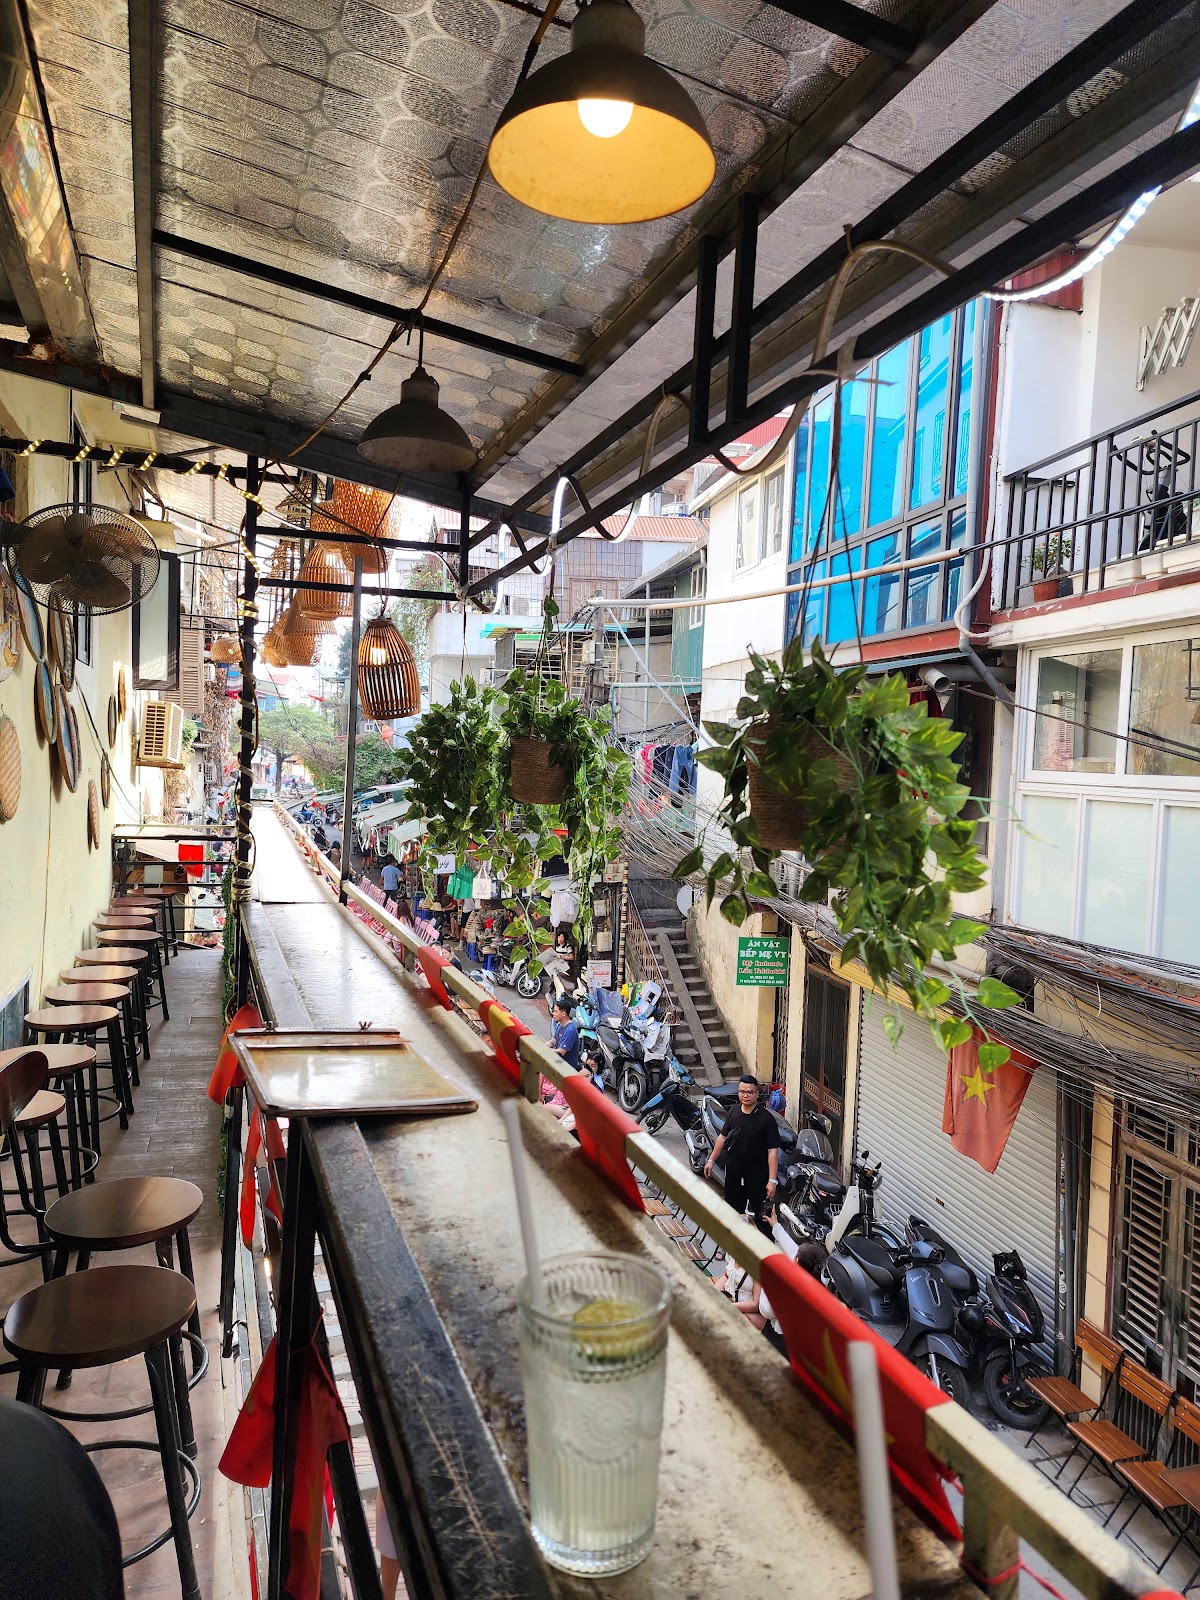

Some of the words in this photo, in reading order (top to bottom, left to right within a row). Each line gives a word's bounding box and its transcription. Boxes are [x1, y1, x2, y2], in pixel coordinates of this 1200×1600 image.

[762, 940, 780, 948] VẶT
[740, 948, 757, 957] BẾP
[759, 950, 772, 959] MẸ
